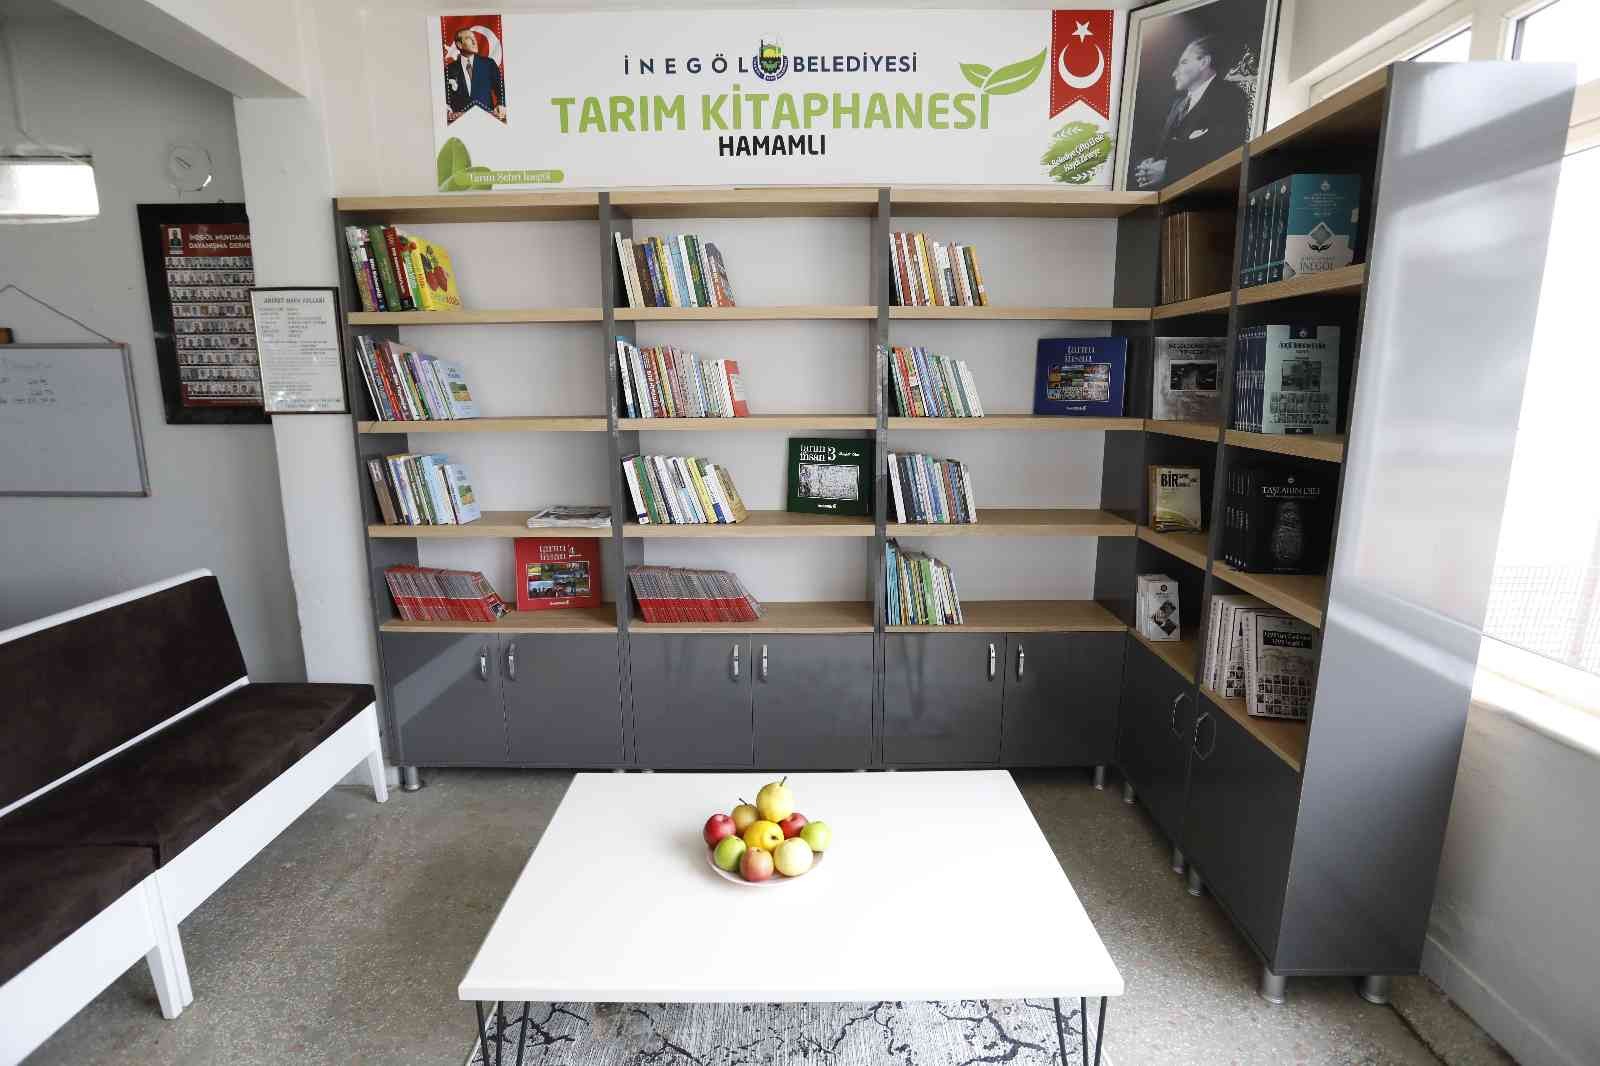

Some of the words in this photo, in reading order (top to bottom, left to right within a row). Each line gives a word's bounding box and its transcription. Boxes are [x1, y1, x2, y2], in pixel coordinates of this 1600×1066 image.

[624, 53, 749, 75] İNEGÖL
[793, 52, 917, 73] BELEDİYESİ
[550, 94, 686, 133] TARIM
[718, 134, 826, 157] HAMAMLI
[827, 446, 837, 461] 3
